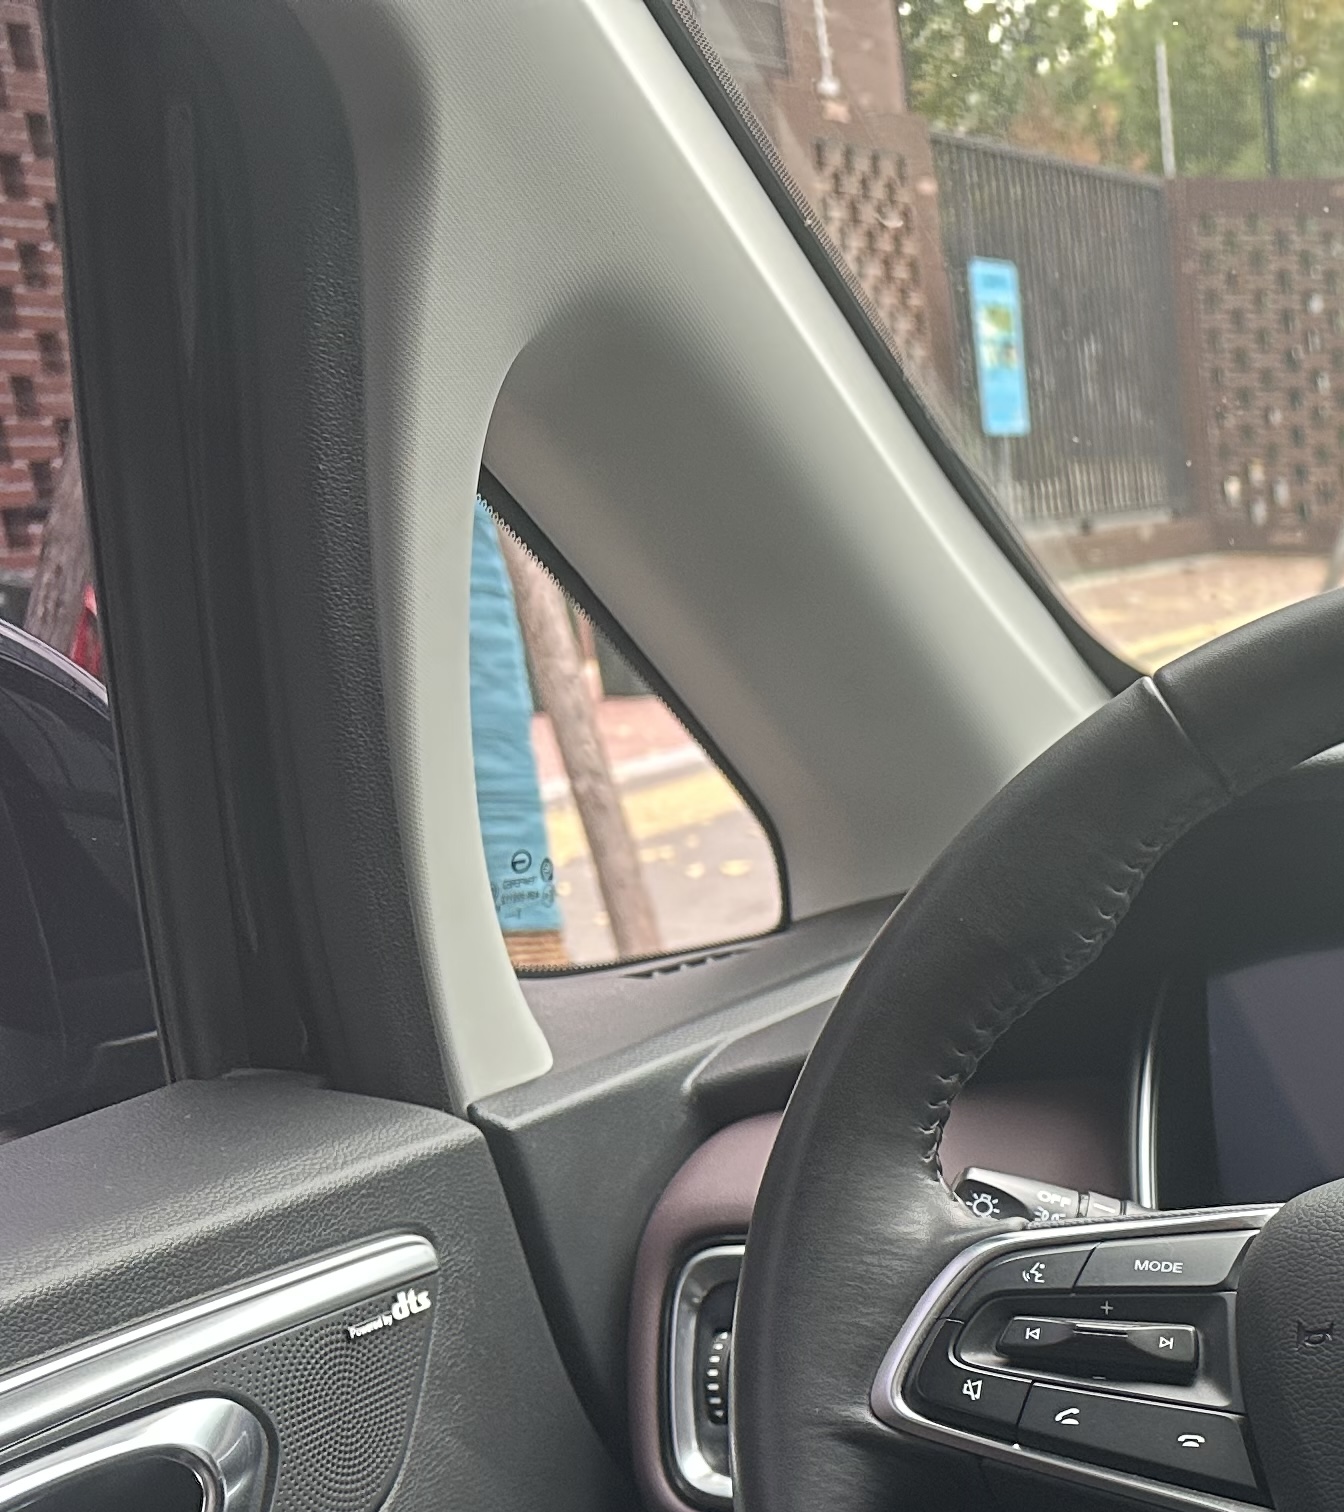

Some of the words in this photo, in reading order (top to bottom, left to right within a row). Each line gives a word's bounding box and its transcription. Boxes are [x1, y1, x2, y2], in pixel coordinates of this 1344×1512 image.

[1036, 1190, 1072, 1208] OFF
[1134, 1259, 1184, 1274] MODE
[392, 1288, 432, 1321] dts
